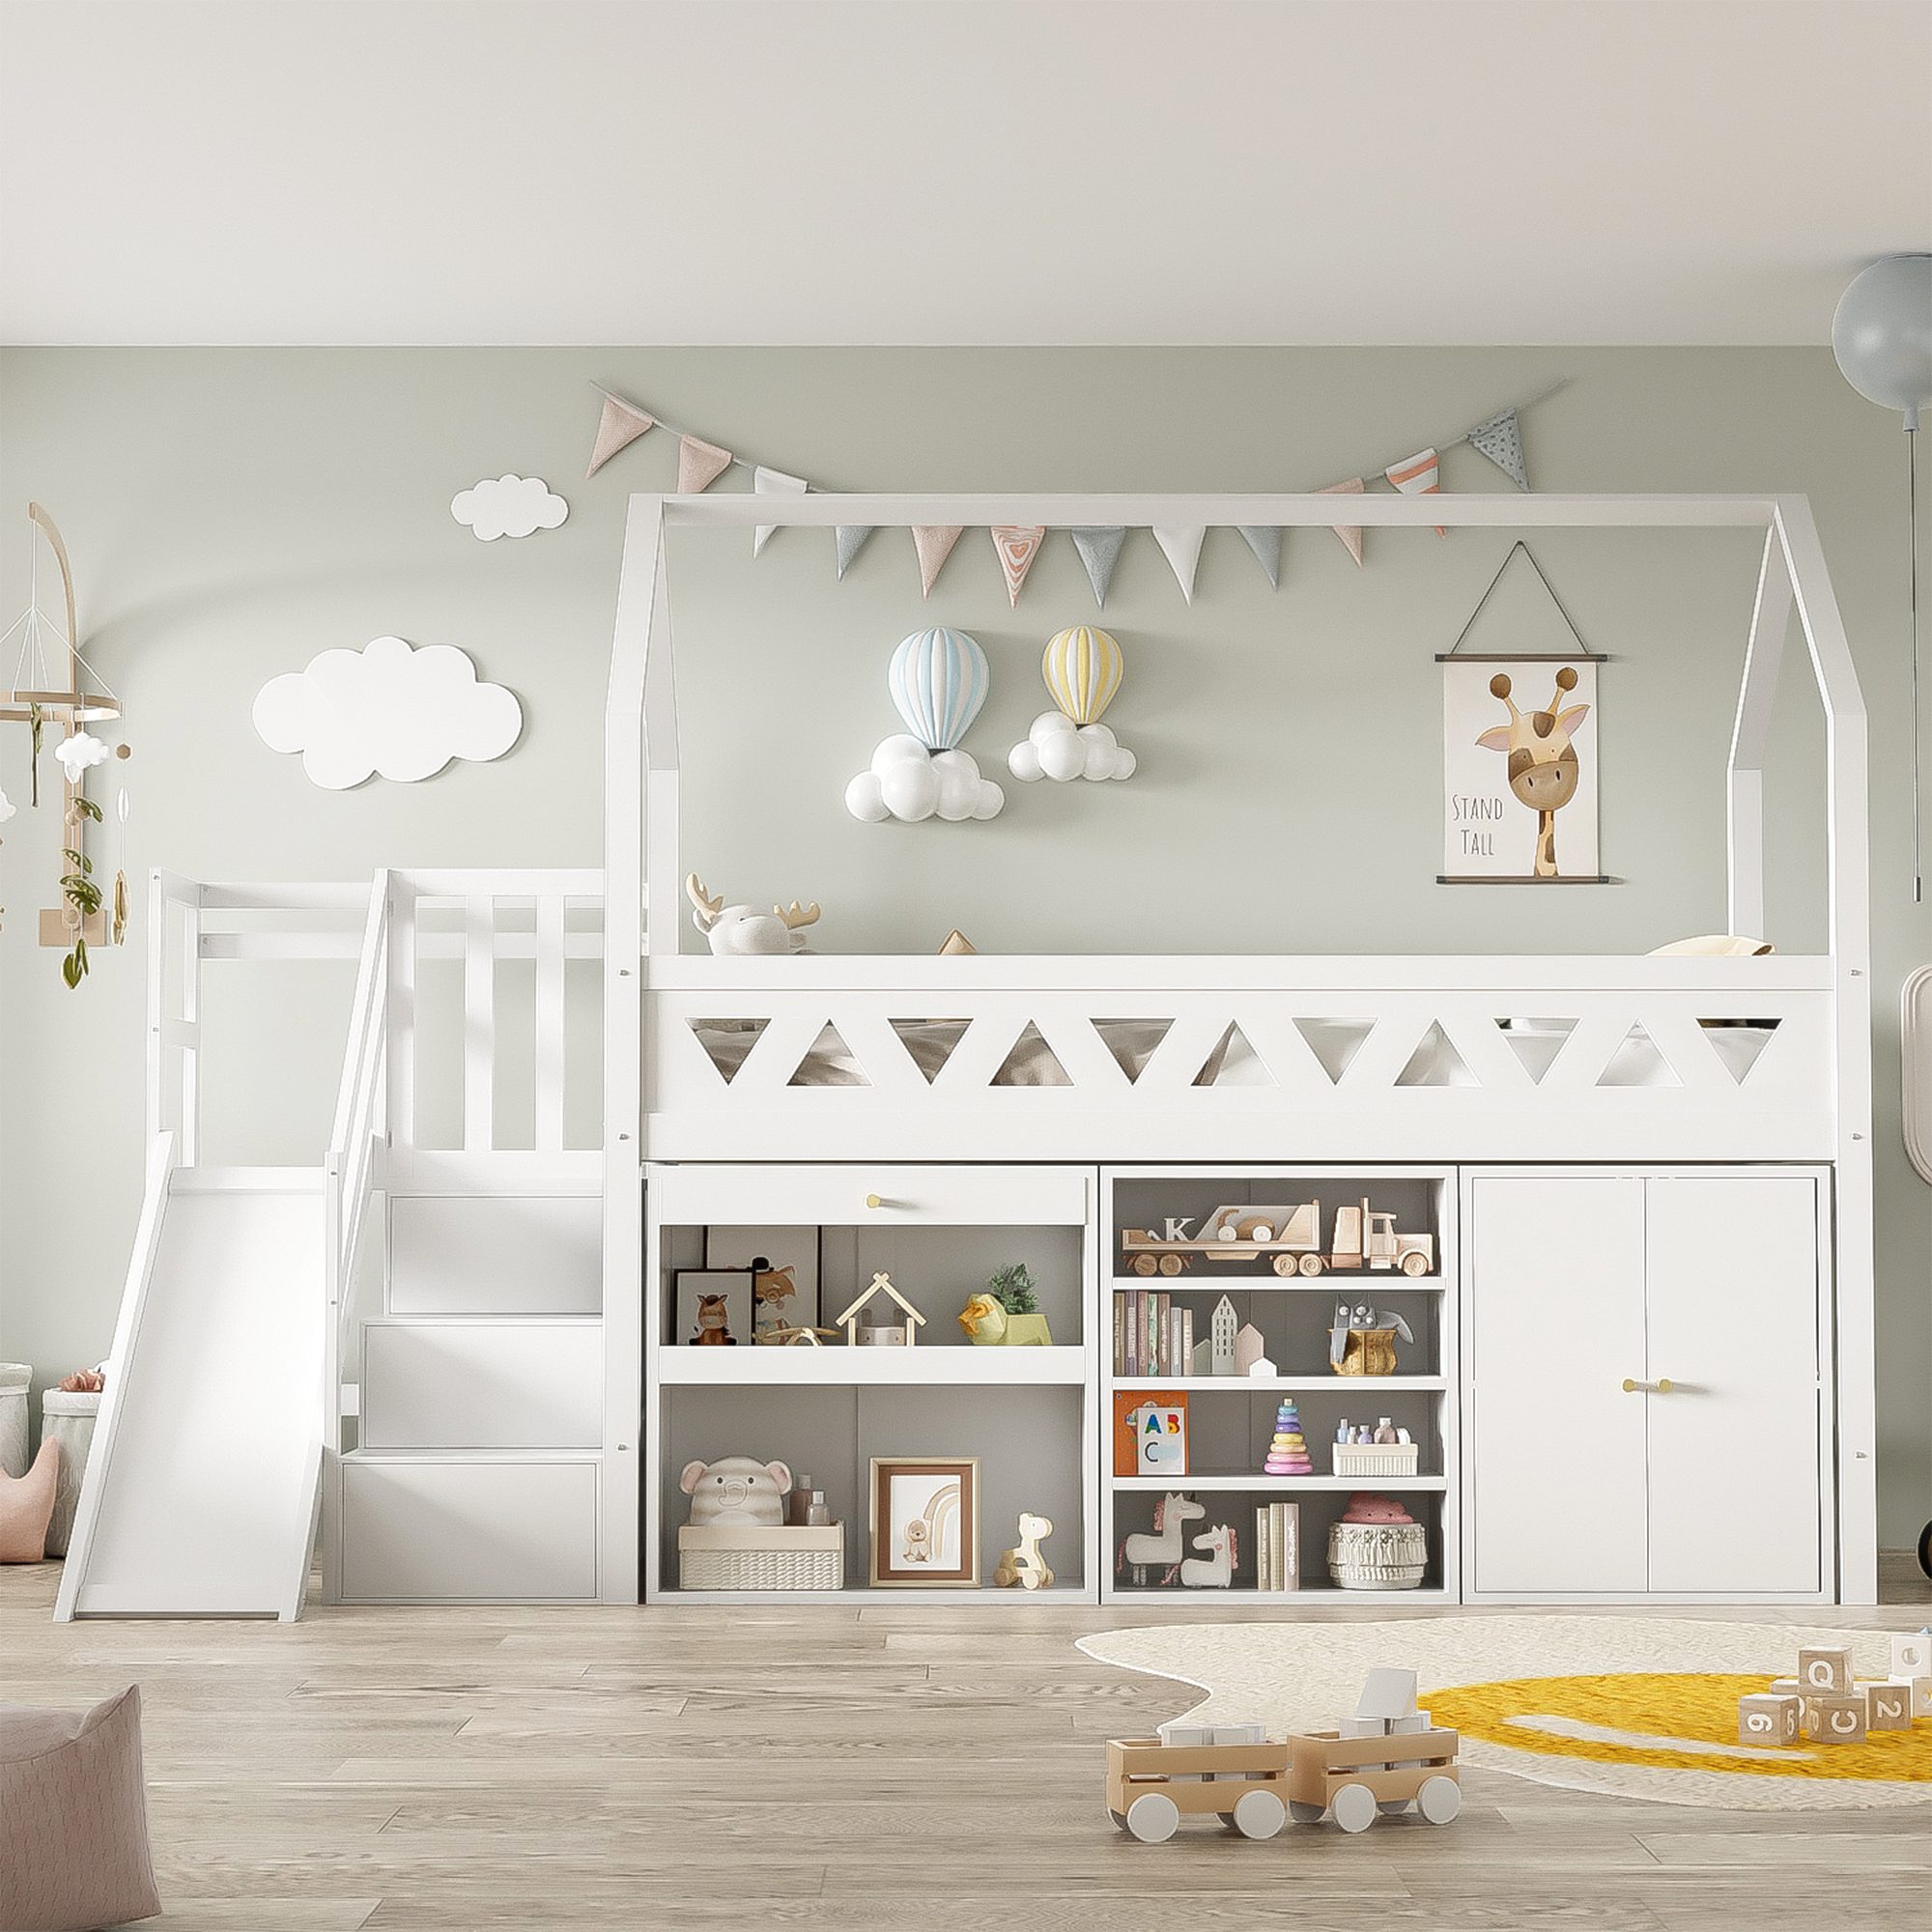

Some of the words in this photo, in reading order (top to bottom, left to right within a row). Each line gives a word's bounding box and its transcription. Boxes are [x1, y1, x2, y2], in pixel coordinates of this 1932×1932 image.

[1452, 794, 1503, 821] STAND
[1461, 829, 1494, 856] TALL
[1164, 1217, 1195, 1242] K
[1807, 1660, 1834, 1690] Q
[1831, 1710, 1858, 1734] C
[1877, 1700, 1902, 1719] 2
